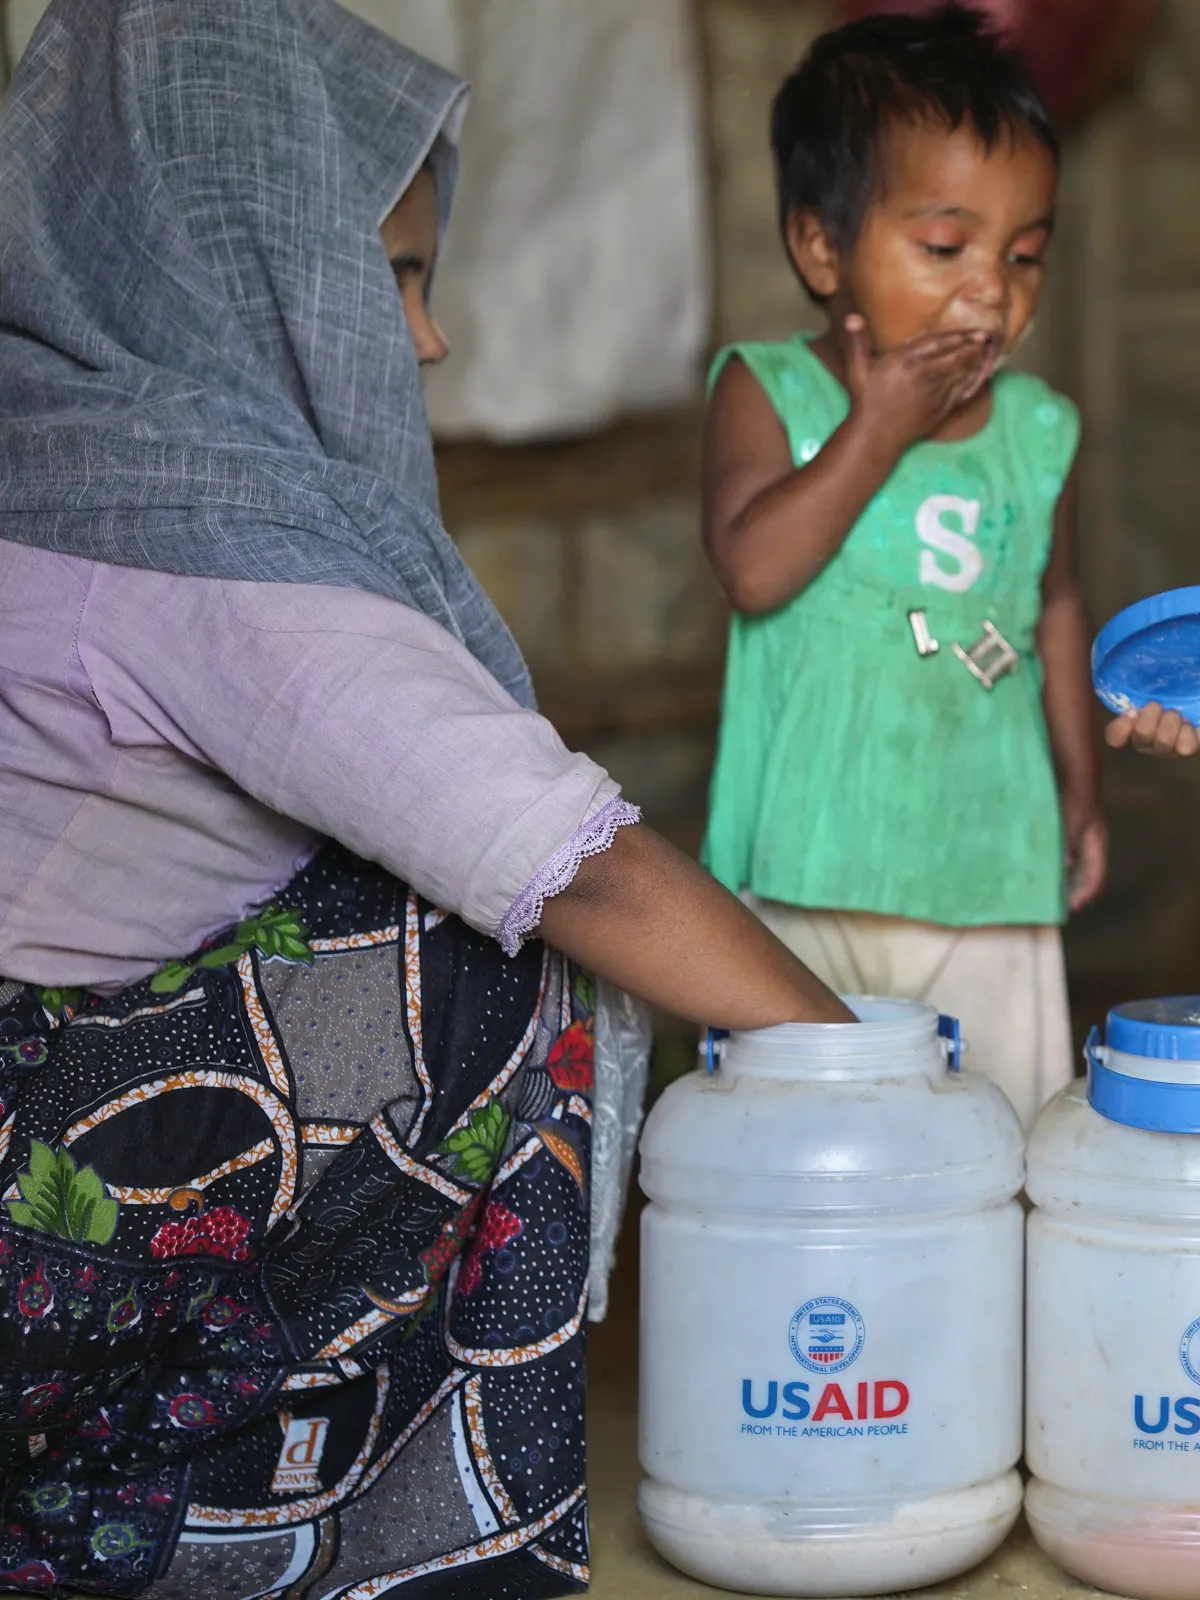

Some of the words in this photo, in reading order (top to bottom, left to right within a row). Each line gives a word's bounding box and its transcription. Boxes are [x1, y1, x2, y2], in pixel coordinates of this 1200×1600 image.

[915, 494, 983, 592] S
[794, 1303, 814, 1322] UNITED
[840, 1302, 861, 1322] AGENCY
[790, 1335, 828, 1372] INTERNATIONAL
[829, 1335, 863, 1372] DEVELOPMENT
[742, 1379, 910, 1421] USAID
[741, 1424, 772, 1436] FROM
[776, 1426, 798, 1437] THE
[801, 1427, 864, 1438] AMERICAN
[867, 1424, 908, 1436] PEOPLE
[1133, 1439, 1164, 1450] FROM
[1167, 1441, 1190, 1451] THE
